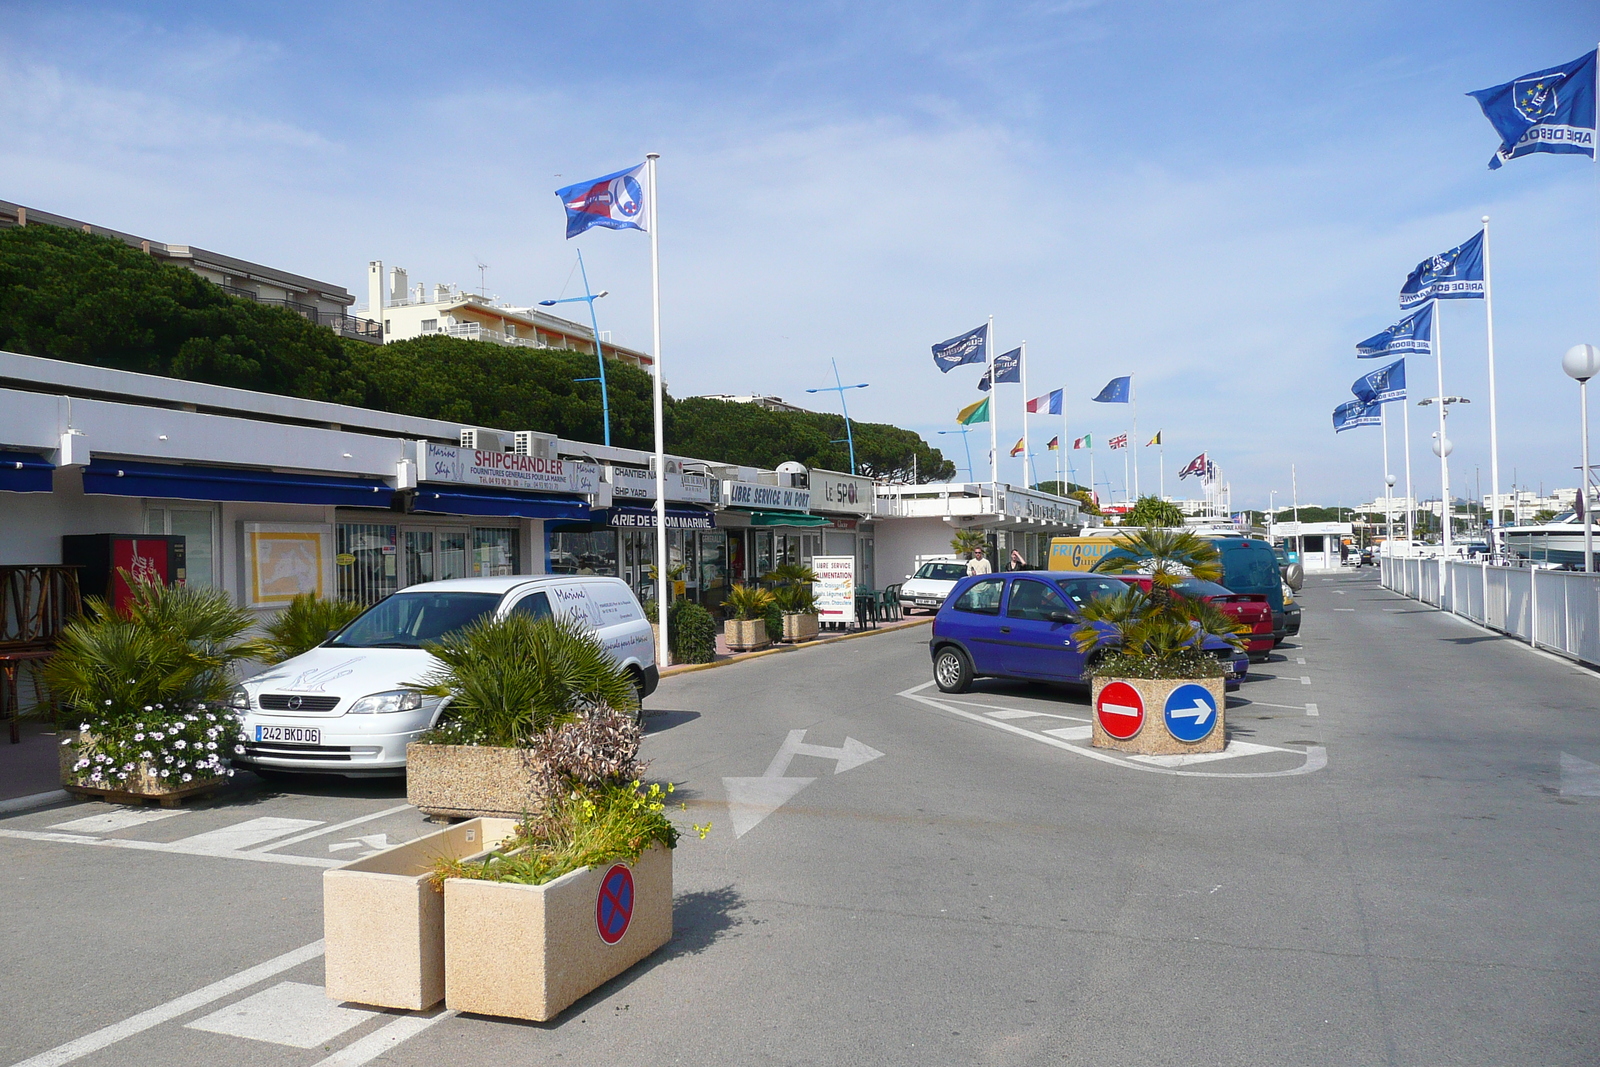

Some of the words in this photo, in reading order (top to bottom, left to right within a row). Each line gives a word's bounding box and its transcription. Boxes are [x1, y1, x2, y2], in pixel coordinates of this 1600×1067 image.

[428, 443, 457, 459] Marine
[474, 451, 563, 475] SHIPCHANDLER
[470, 467, 505, 478] FOURNITURES
[505, 471, 531, 480] GENERALES
[531, 473, 544, 481] POUR
[550, 475, 567, 483] MARINE
[614, 467, 647, 480] CHANTIER
[647, 470, 668, 481] NAL
[614, 486, 629, 496] SHIP
[630, 487, 647, 498] YARD
[731, 485, 752, 502] LIBRE
[753, 487, 781, 505] SERVICE
[783, 490, 793, 506] DU
[794, 492, 810, 508] PORT
[611, 514, 636, 526] ARIE
[636, 515, 651, 527] DE
[651, 515, 679, 528] BOM
[679, 517, 712, 529] MARINE
[815, 571, 853, 579] ALIMENTATION
[554, 588, 586, 603] Marine
[262, 727, 282, 741] 242
[284, 728, 303, 742] BKD
[304, 729, 318, 743] 06
